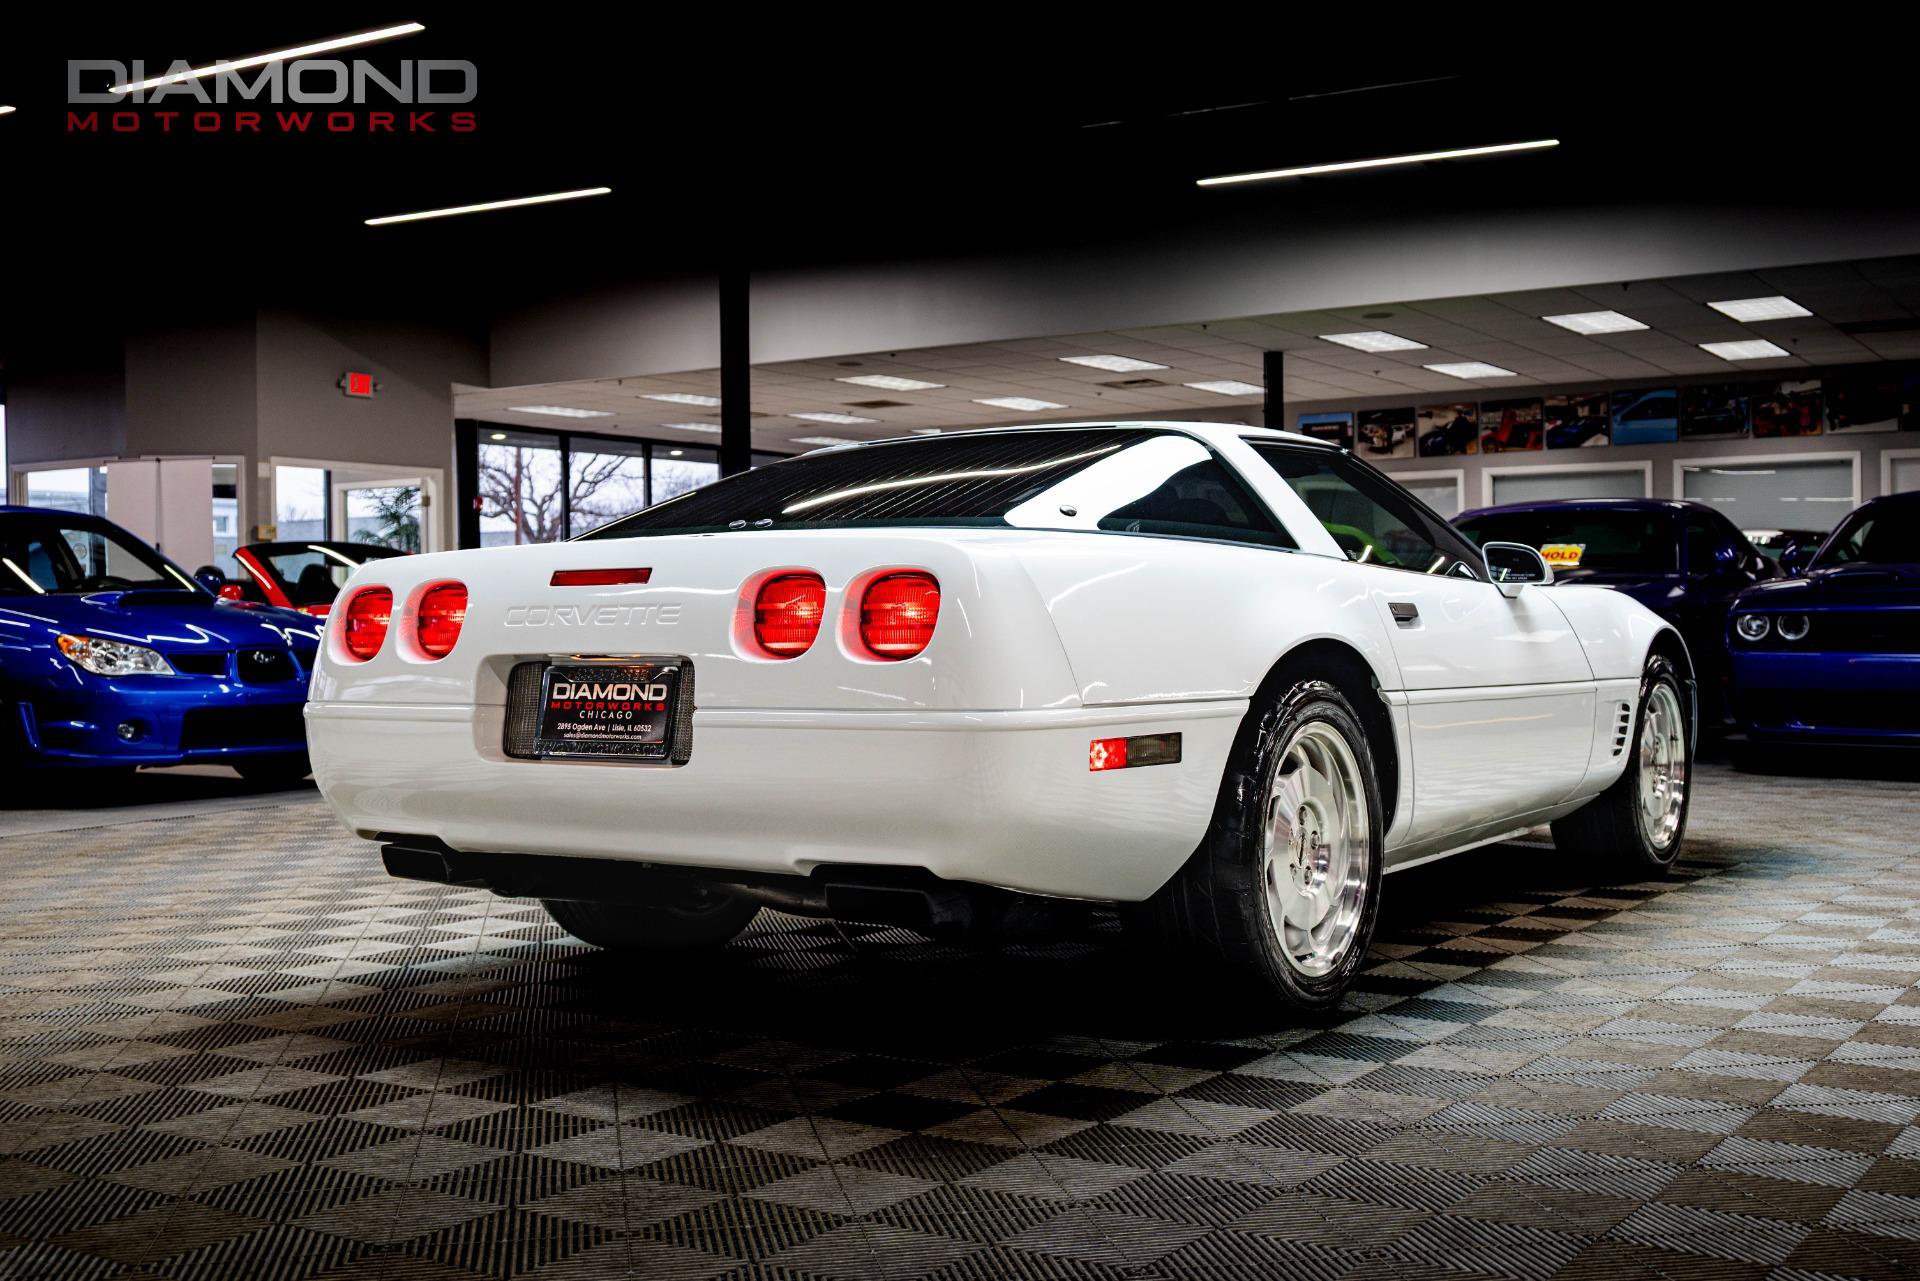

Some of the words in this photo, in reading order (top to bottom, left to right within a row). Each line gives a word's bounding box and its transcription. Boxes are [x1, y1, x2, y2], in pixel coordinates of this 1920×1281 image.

[504, 602, 682, 627] CORVETTE
[552, 683, 668, 700] DIAMOND
[550, 701, 666, 711] MOTORWORKS
[579, 710, 633, 720] CHICAGO
[572, 723, 593, 731] Ogden
